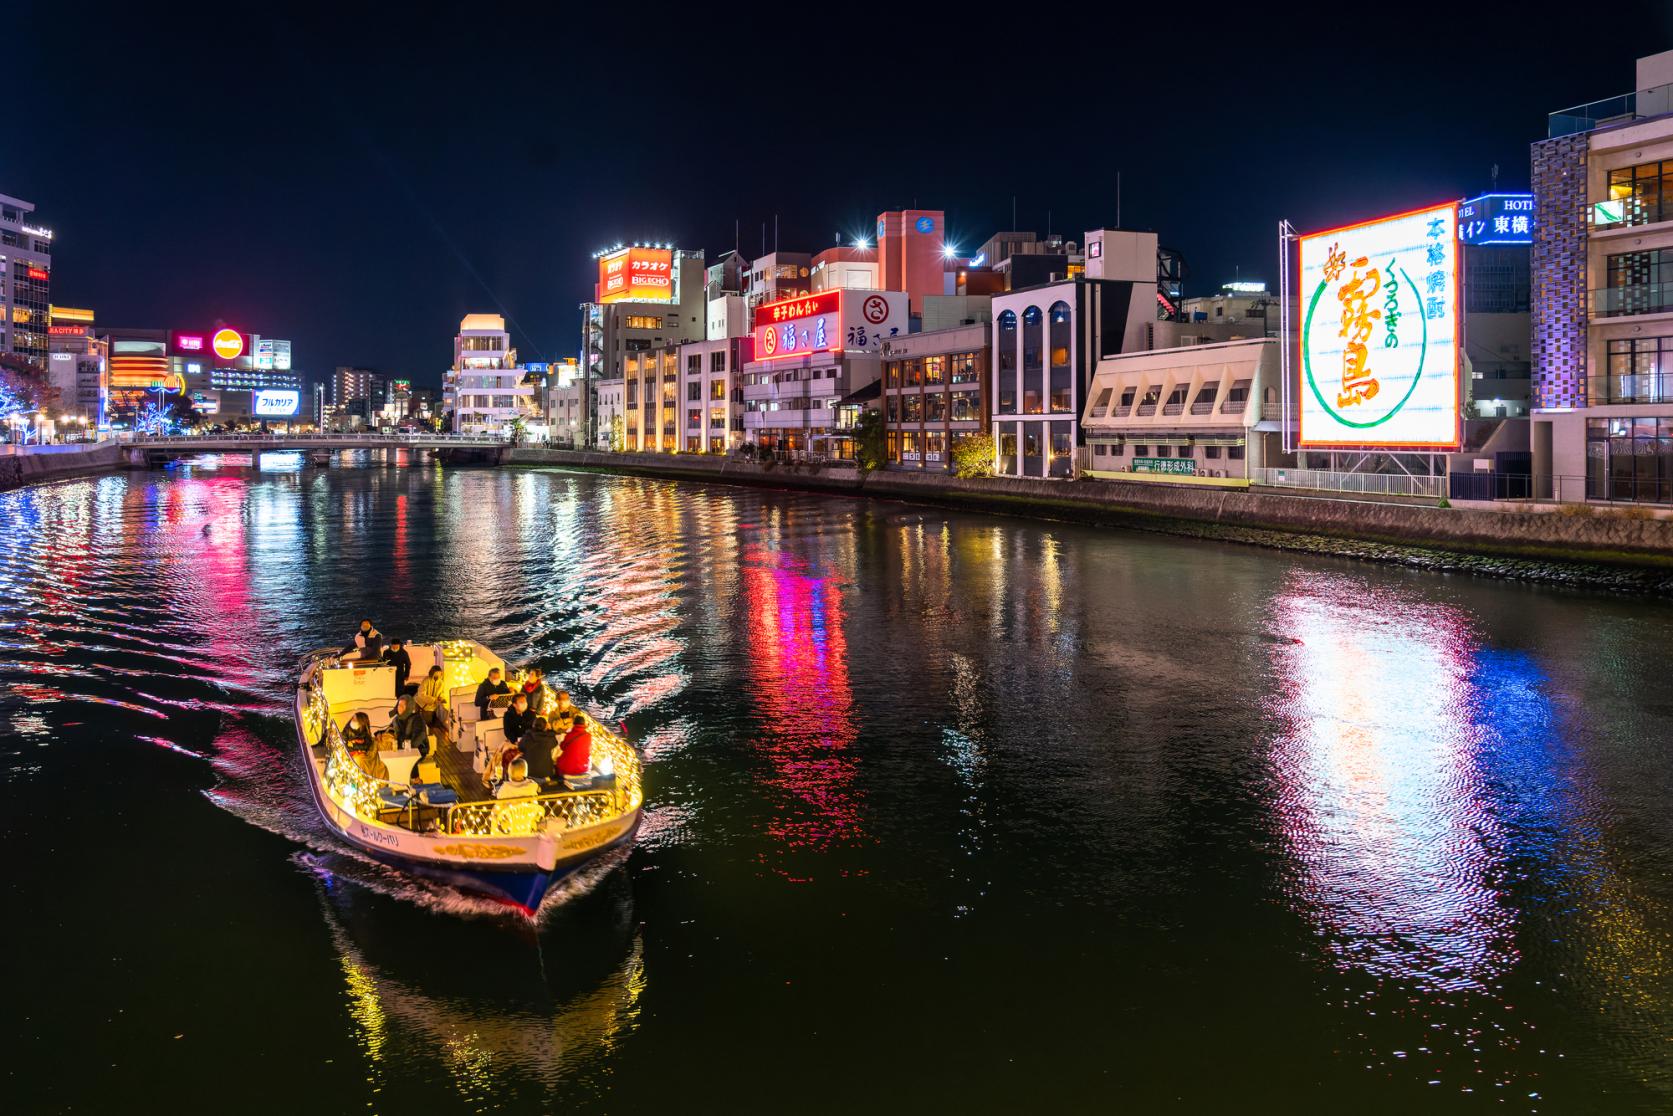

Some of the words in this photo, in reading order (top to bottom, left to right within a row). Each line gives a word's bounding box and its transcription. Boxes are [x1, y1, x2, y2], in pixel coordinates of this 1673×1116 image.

[1494, 215, 1535, 234] 東横
[631, 261, 669, 271] カラオケ
[631, 276, 647, 285] BIG
[647, 277, 669, 286] ECHO
[1383, 257, 1402, 349] くつろぎの
[782, 317, 828, 352] 福さ屋
